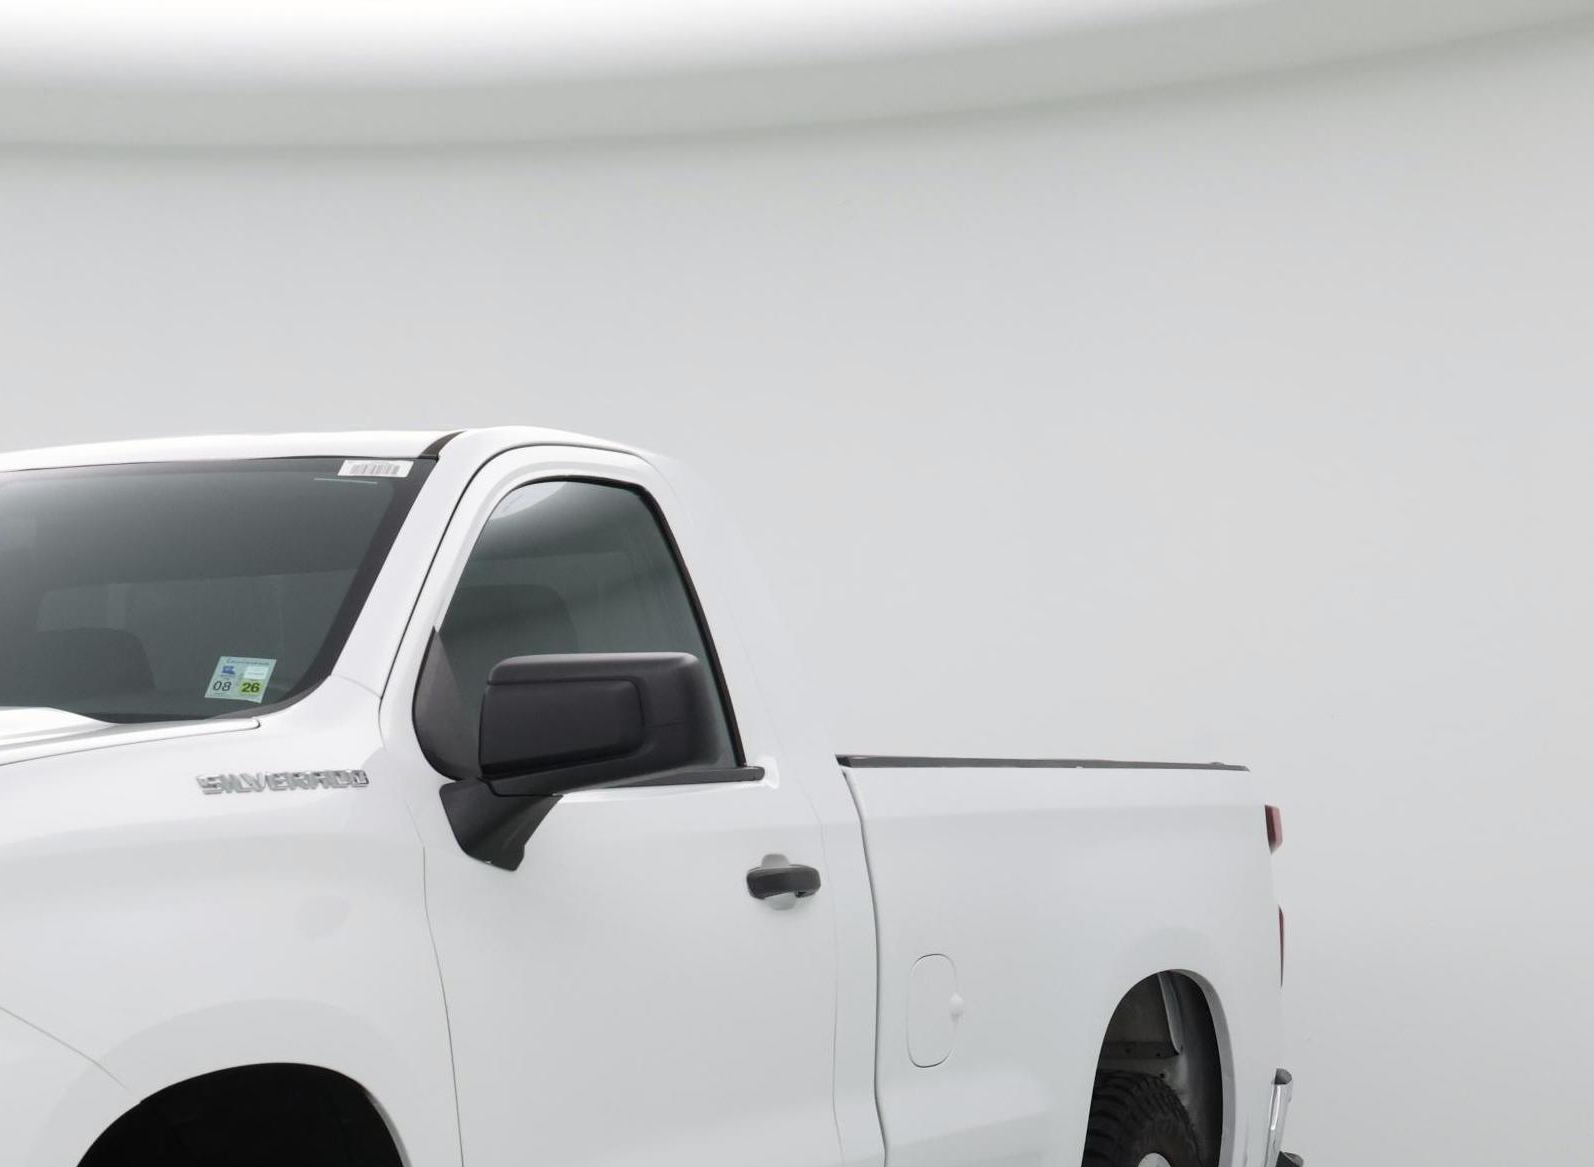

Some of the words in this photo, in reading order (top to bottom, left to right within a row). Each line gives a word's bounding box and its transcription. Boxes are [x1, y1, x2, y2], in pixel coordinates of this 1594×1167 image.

[213, 680, 232, 692] 08
[241, 682, 260, 693] 26
[196, 770, 369, 795] SILVERADO
